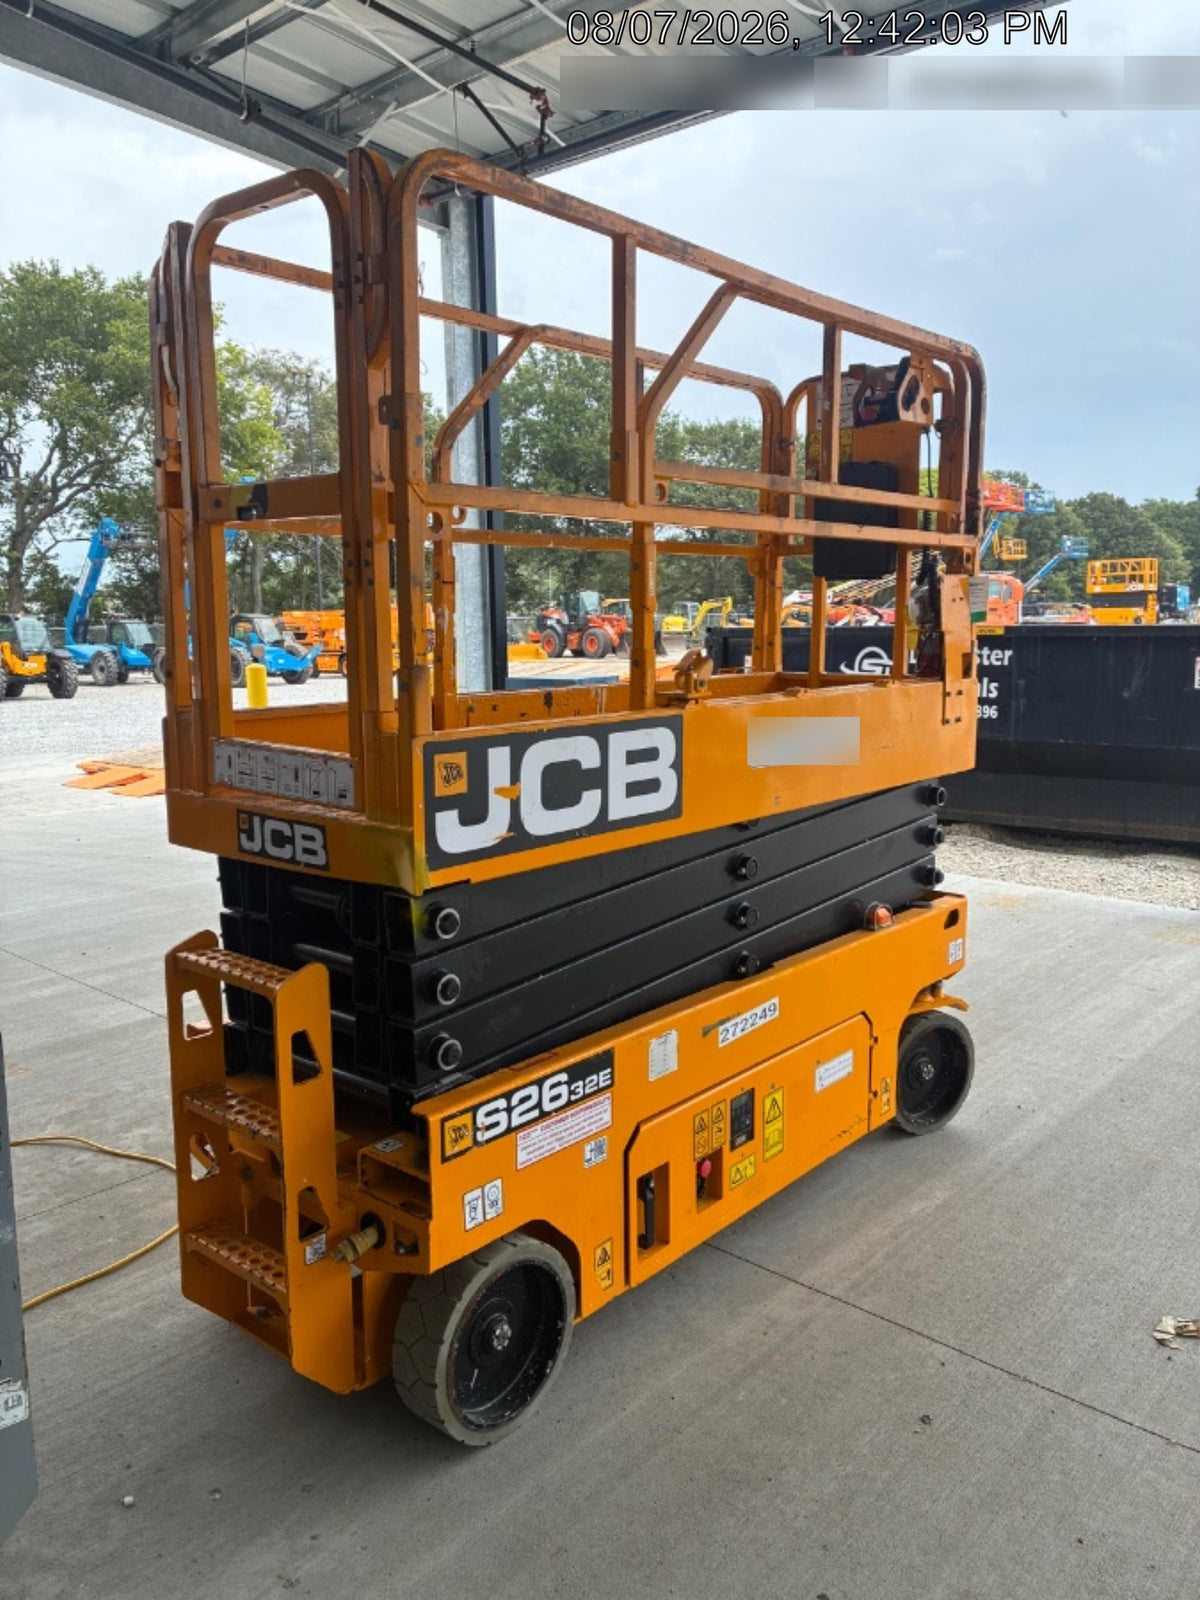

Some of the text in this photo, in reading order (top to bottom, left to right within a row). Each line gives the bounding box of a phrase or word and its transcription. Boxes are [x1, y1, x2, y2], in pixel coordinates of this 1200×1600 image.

[434, 726, 678, 854] JCB
[239, 815, 328, 866] JCB
[720, 1002, 777, 1044] 272249
